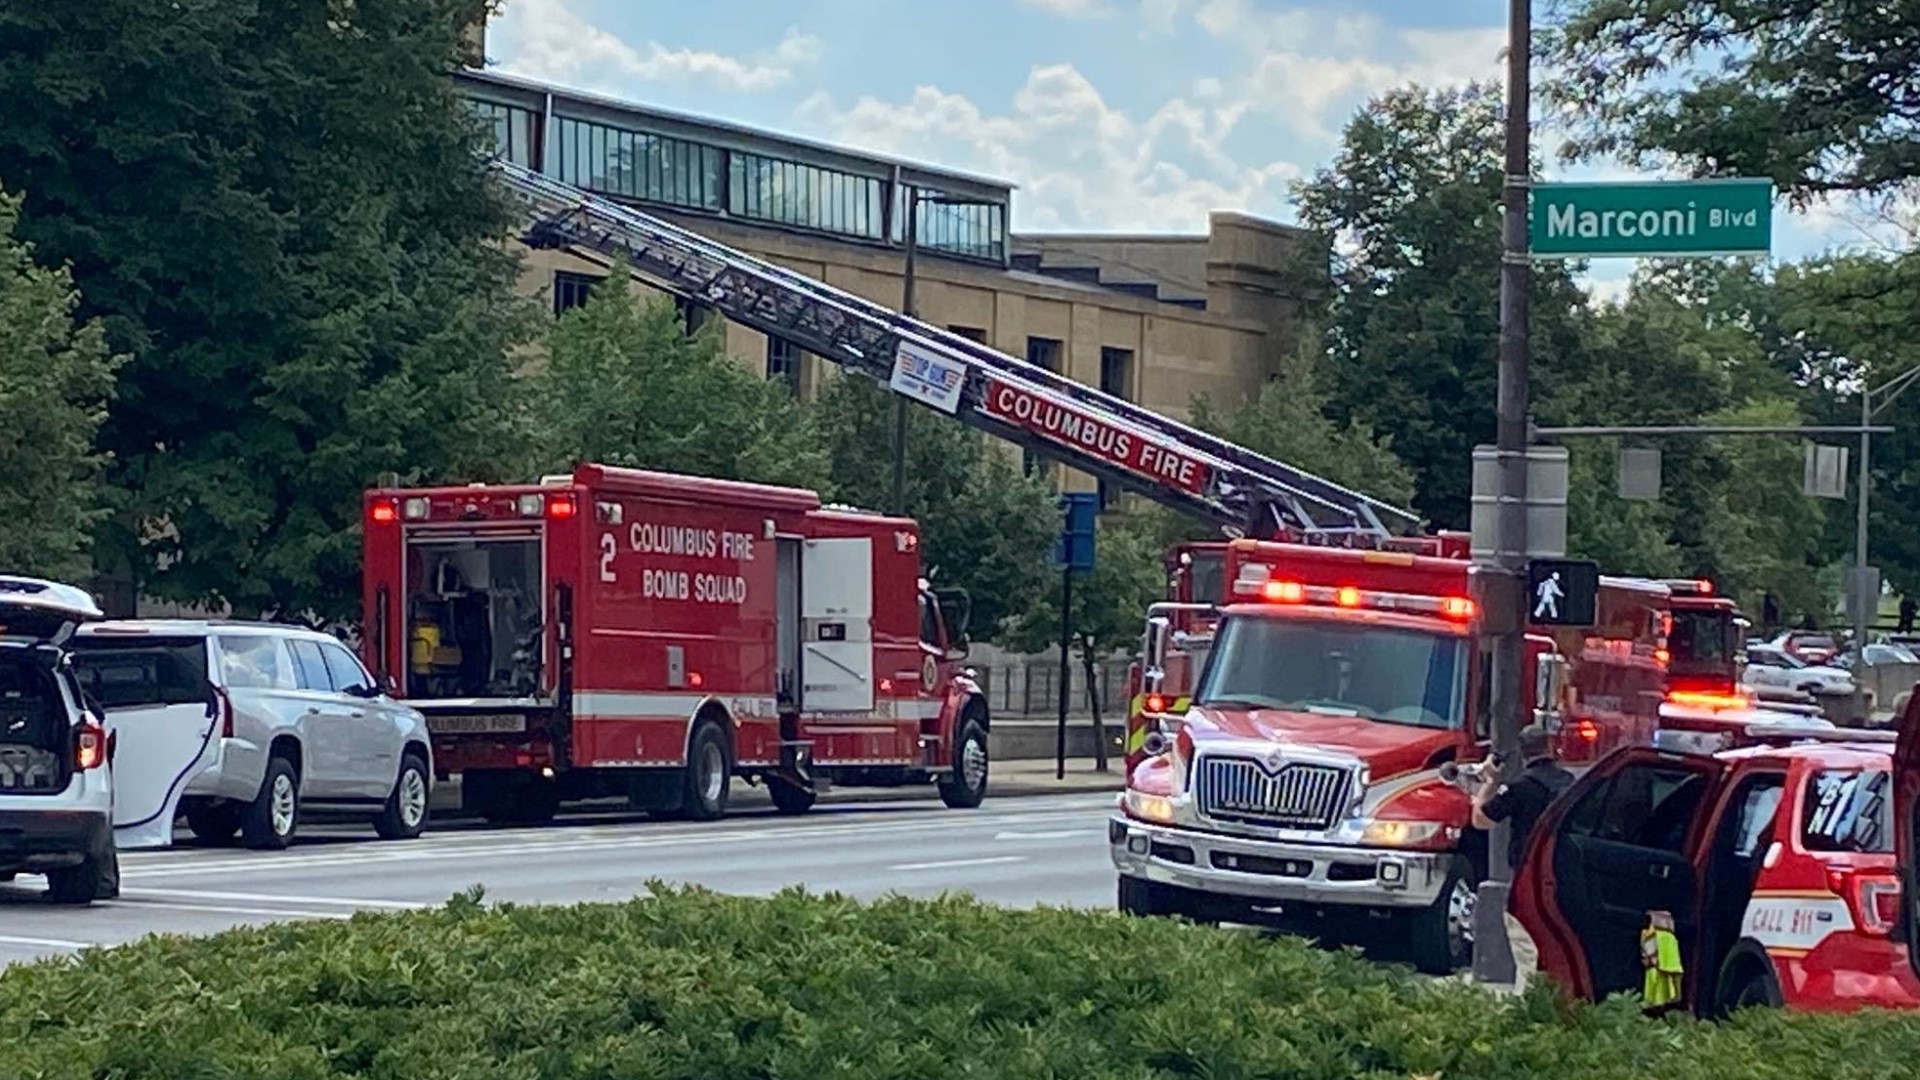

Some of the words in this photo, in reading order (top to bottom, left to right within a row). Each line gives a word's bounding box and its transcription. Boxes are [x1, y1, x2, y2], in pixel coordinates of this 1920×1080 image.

[1547, 201, 1696, 238] Marconi
[1709, 208, 1757, 228] Blvd
[998, 388, 1132, 459] COLUMBUS
[1139, 444, 1197, 485] FIRE
[601, 532, 617, 582] 2
[630, 522, 717, 558] COLUMBUS
[722, 531, 755, 561] FIRE
[643, 569, 689, 600] BOMB
[694, 573, 747, 604] SQUAD
[1751, 907, 1784, 933] CALL
[1791, 908, 1814, 935] 911
